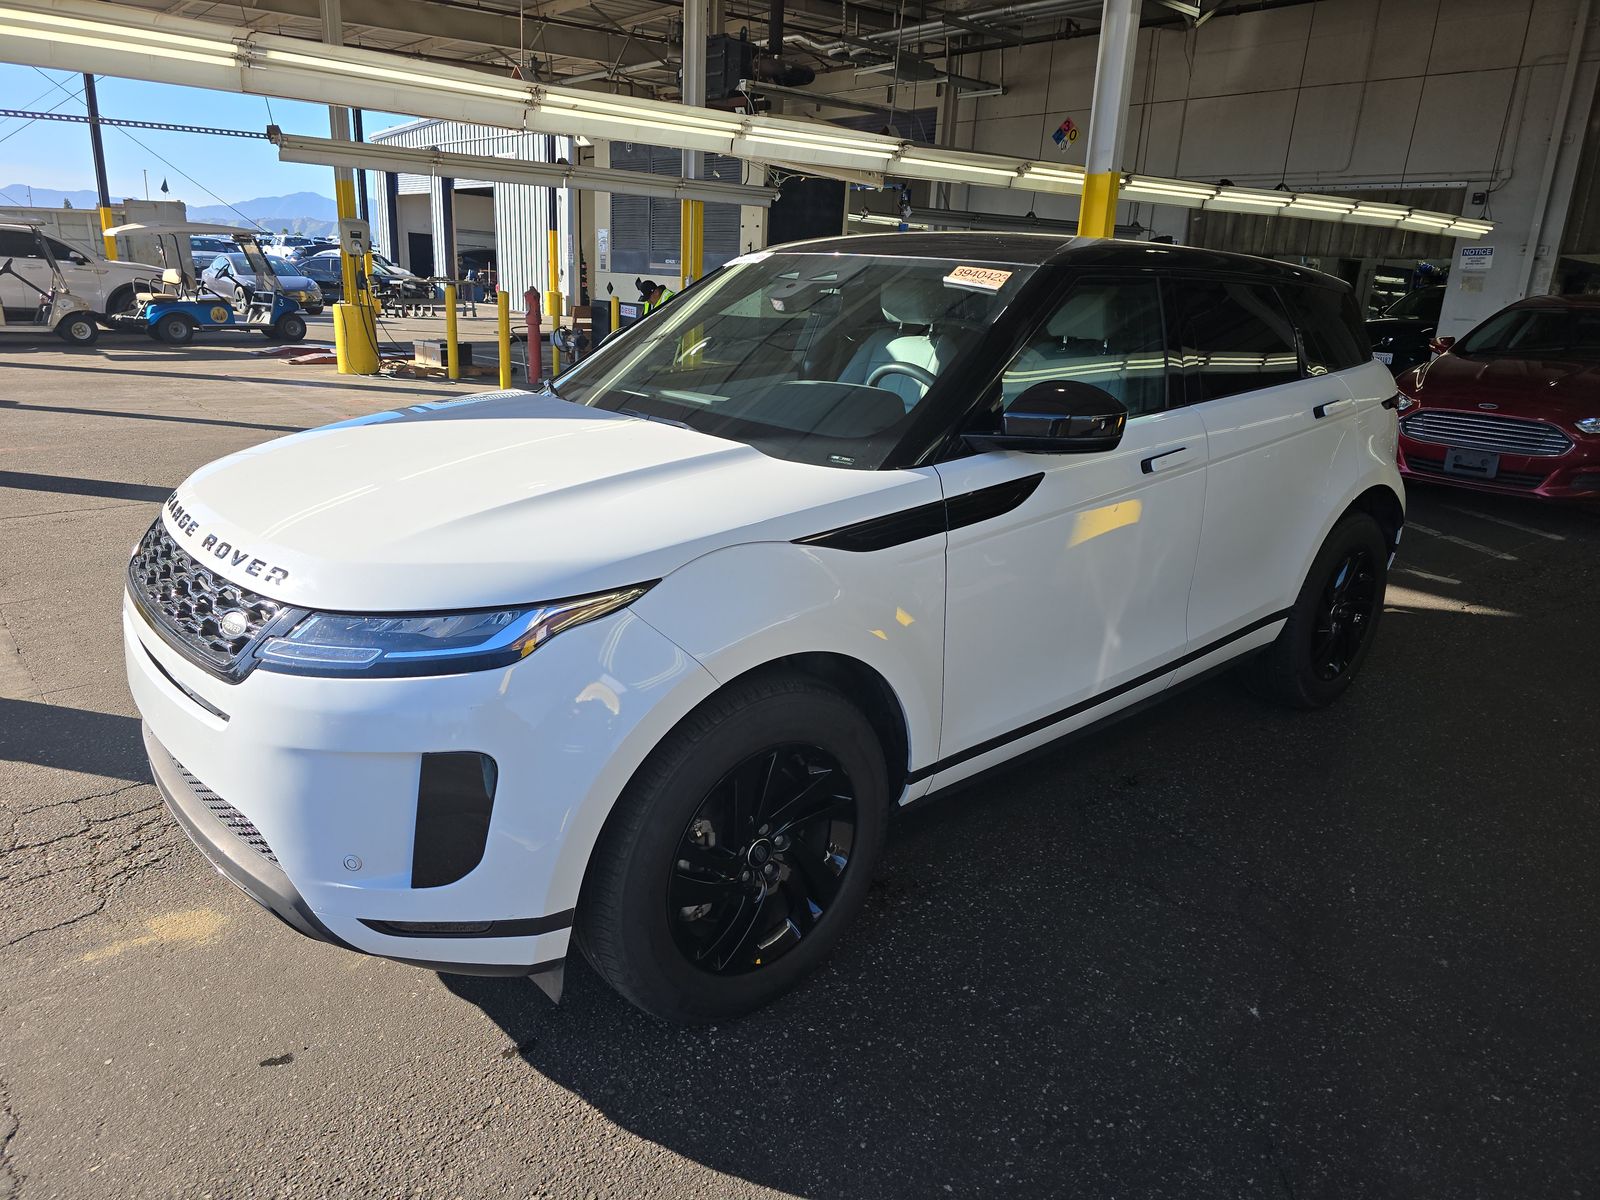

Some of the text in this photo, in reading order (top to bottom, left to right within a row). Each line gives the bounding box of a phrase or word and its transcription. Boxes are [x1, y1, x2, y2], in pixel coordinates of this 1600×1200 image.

[1463, 248, 1492, 256] NOTICE
[954, 268, 1009, 283] 3940423
[278, 298, 284, 307] 3
[167, 491, 290, 586] RANGE ROVER
